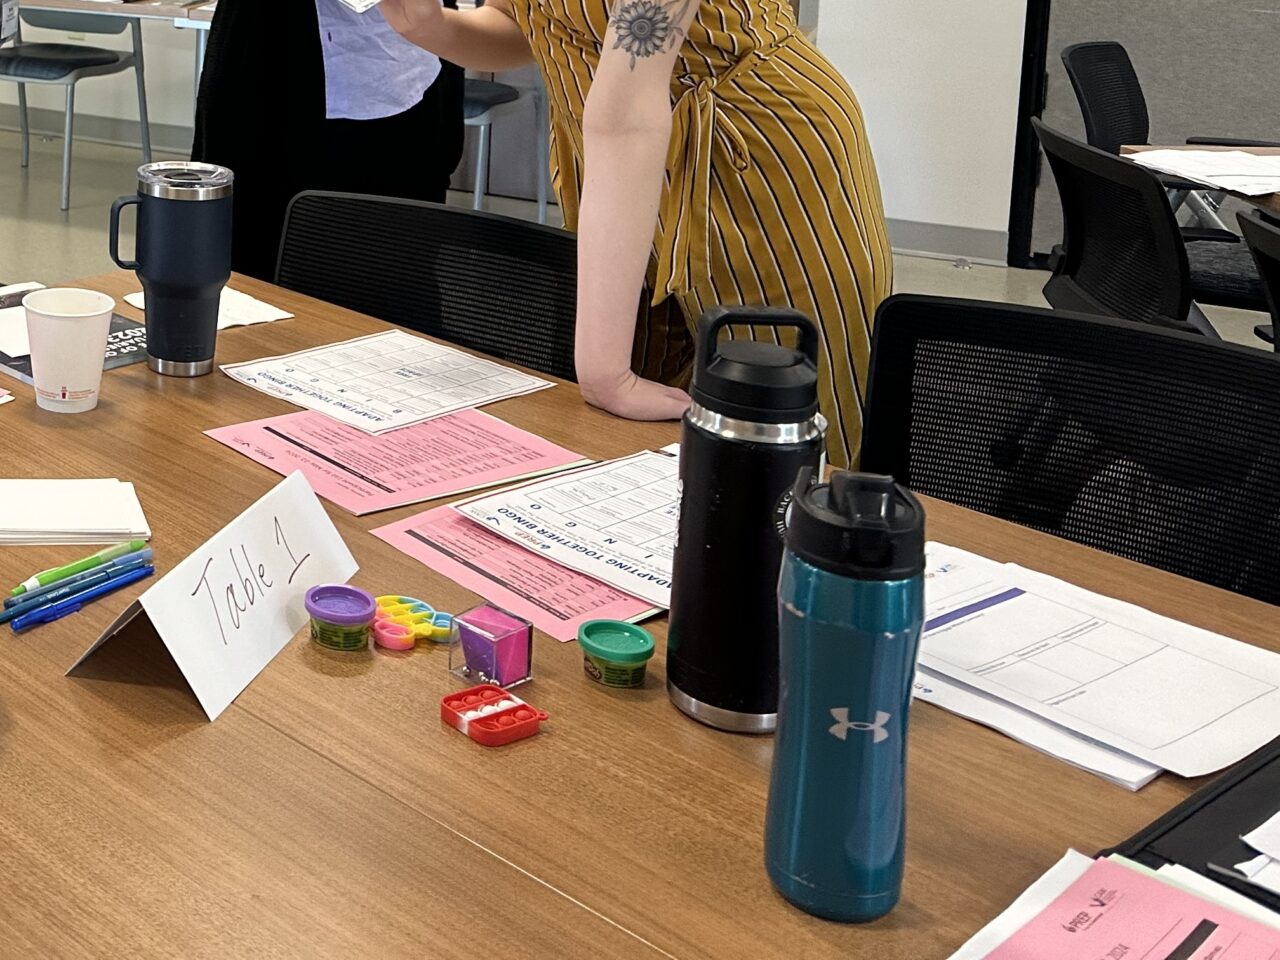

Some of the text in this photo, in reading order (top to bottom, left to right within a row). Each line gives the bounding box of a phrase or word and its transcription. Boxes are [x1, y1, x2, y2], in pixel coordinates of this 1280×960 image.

[257, 372, 286, 387] BINGO
[286, 383, 333, 404] TOGETHER
[335, 401, 384, 422] ADAPTING
[497, 508, 534, 530] BINGO
[514, 531, 541, 546] PREP
[537, 525, 606, 564] TOGETHER
[192, 516, 311, 646] Table 1
[1069, 911, 1092, 929] PREP
